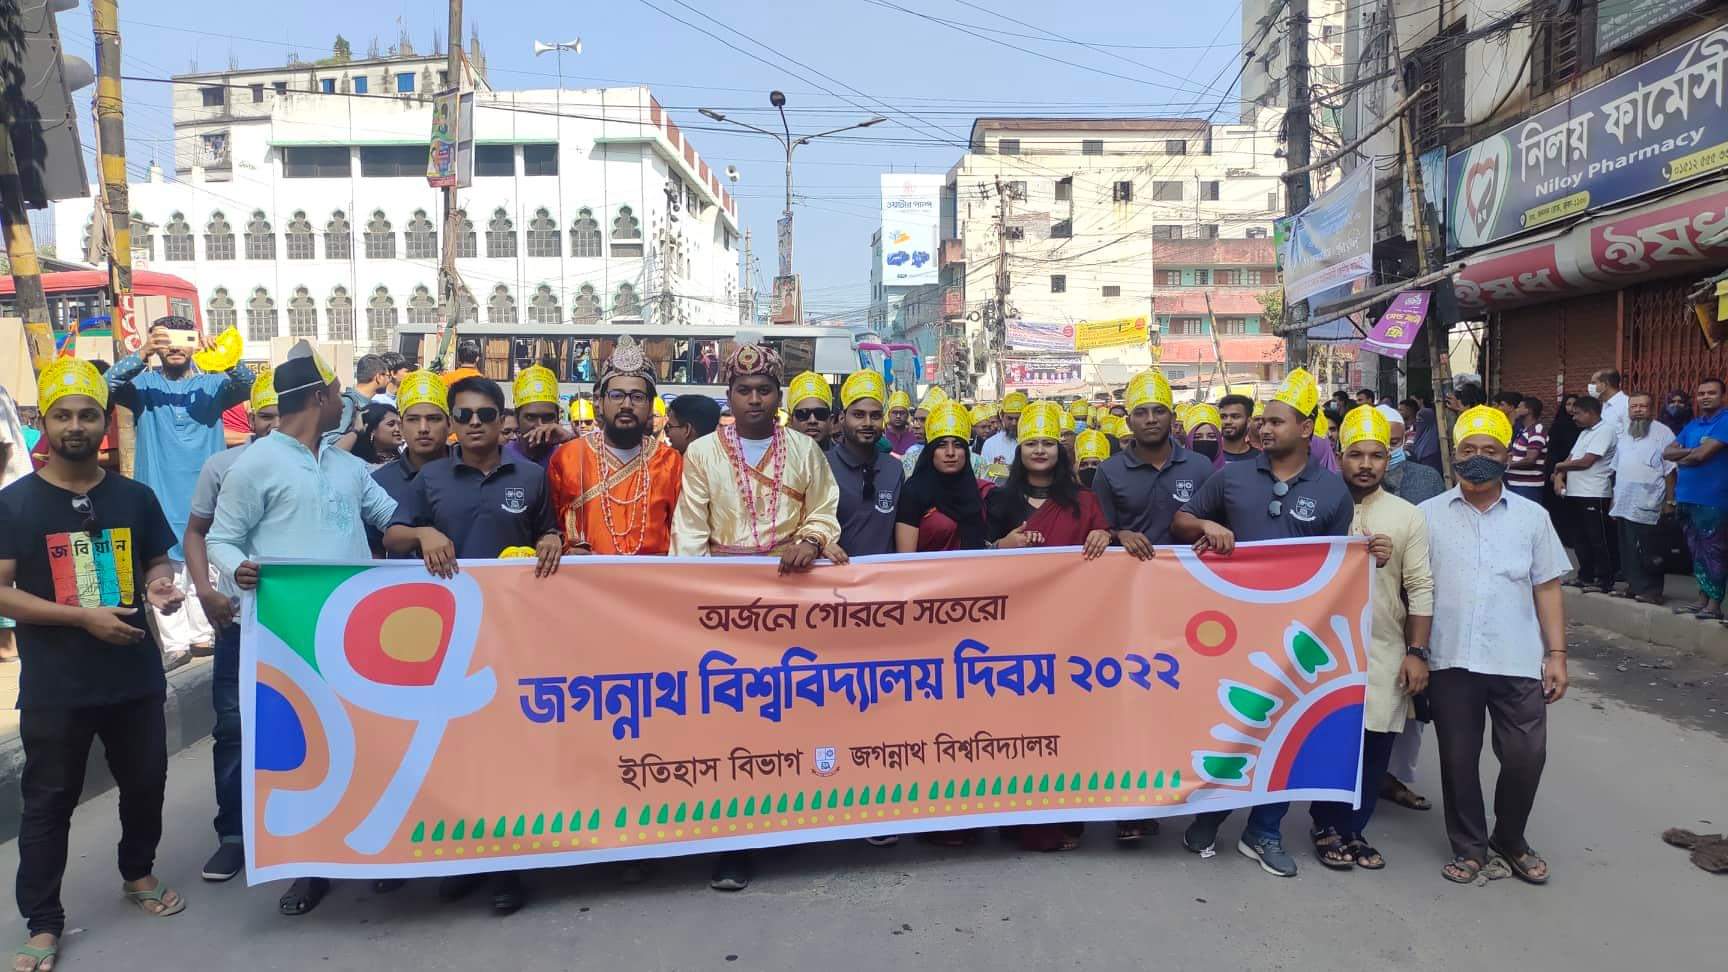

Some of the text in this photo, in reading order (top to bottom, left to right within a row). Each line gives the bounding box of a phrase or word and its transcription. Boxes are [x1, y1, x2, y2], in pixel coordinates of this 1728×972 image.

[1518, 112, 1595, 183] নিলয়
[1535, 126, 1705, 198] Niloy Pharmacy
[698, 588, 1009, 632] অর্জনে গৌরবে সতেরো
[518, 638, 1180, 741] জগন্নাথ বিশ্ববিদ্যালয় দিবস ২০২২
[617, 730, 1061, 791] ইতিহাস বিভাগ জগন্নাথ বিশ্ববিদ্যালয়
